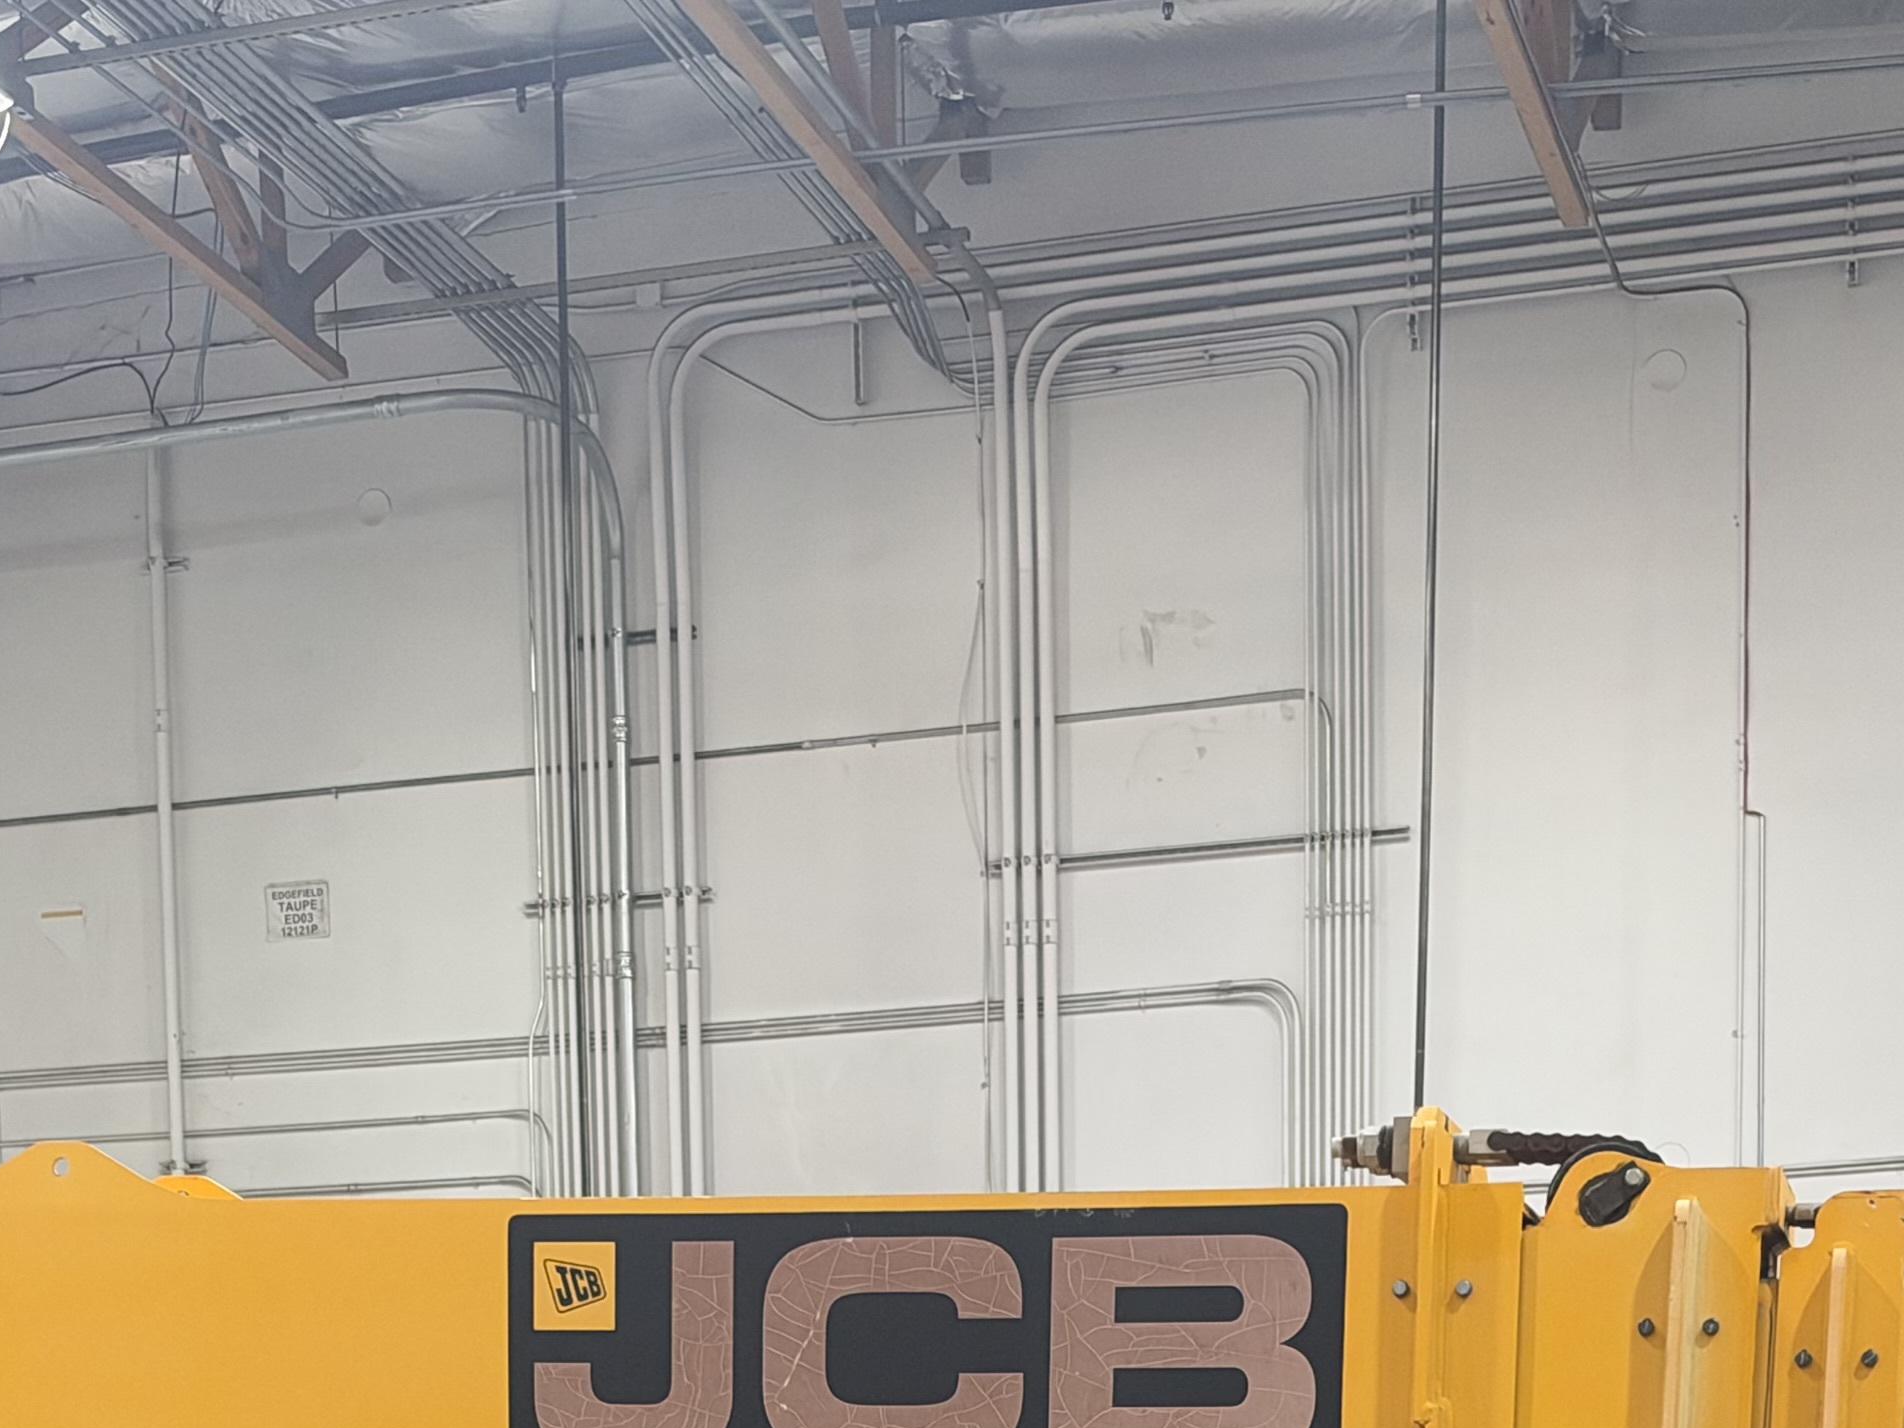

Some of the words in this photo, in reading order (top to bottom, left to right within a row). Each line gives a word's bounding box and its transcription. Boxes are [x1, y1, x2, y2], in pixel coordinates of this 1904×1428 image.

[272, 888, 323, 900] EDGEFIELD
[278, 899, 317, 912] TAUPE
[284, 913, 314, 925] ED03
[554, 1265, 602, 1307] JCB
